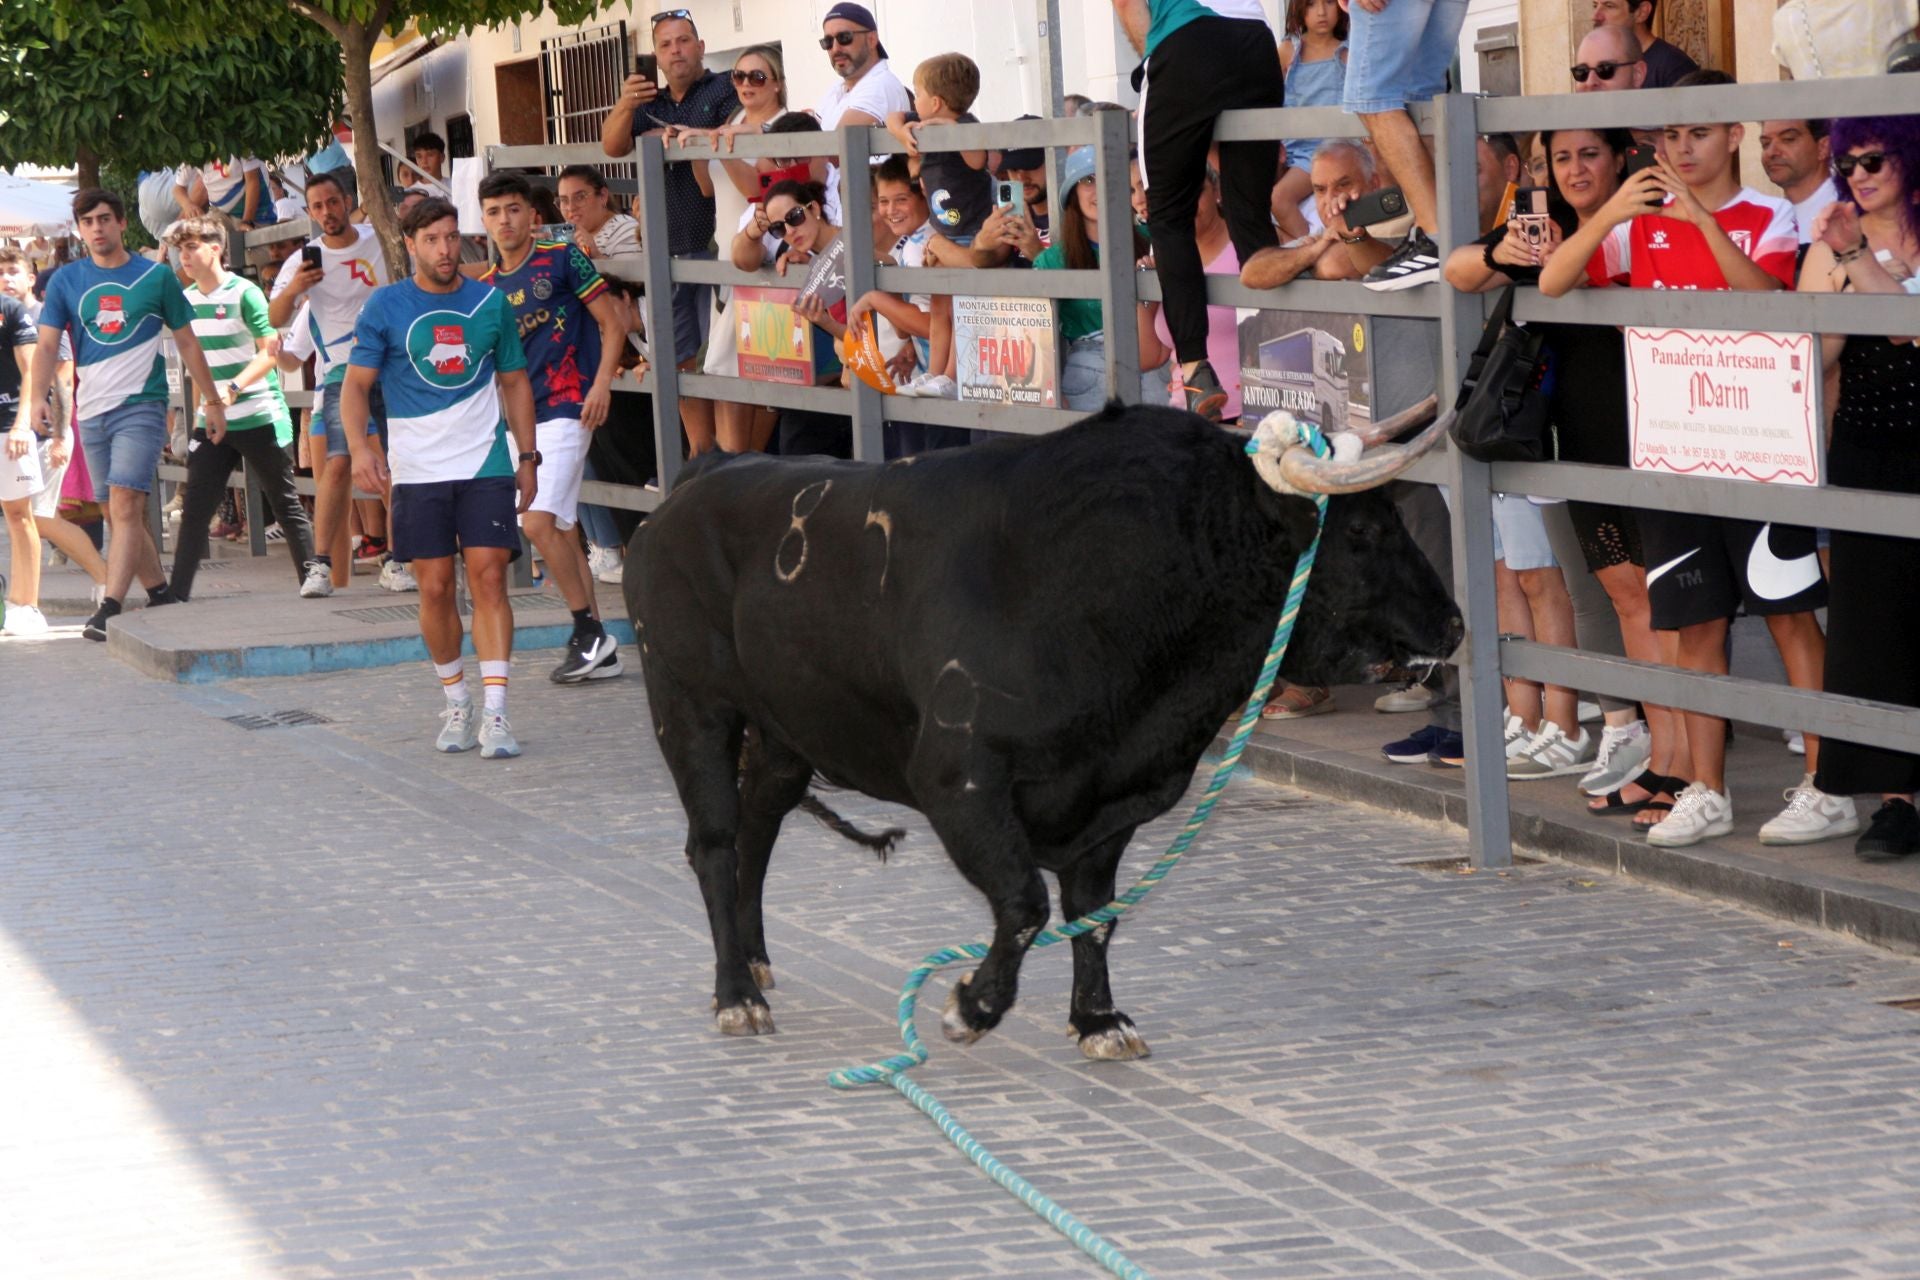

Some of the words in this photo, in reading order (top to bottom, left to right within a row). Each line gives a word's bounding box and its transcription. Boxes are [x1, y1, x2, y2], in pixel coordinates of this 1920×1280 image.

[830, 240, 844, 260] Nos
[959, 301, 998, 311] MONTAJES
[963, 316, 1052, 328] TELECOMUNICACIONES
[978, 337, 1026, 378] FRAN
[1651, 347, 1713, 367] Panadería
[1716, 351, 1776, 370] Artesana
[996, 389, 1002, 400] 22
[1011, 390, 1041, 402] CARCABUEY
[1243, 386, 1280, 408] ANTONIO
[1281, 389, 1316, 412] JURADO
[1688, 371, 1749, 414] Marín
[1734, 450, 1771, 464] CARCABUEY
[1675, 569, 1703, 588] TM
